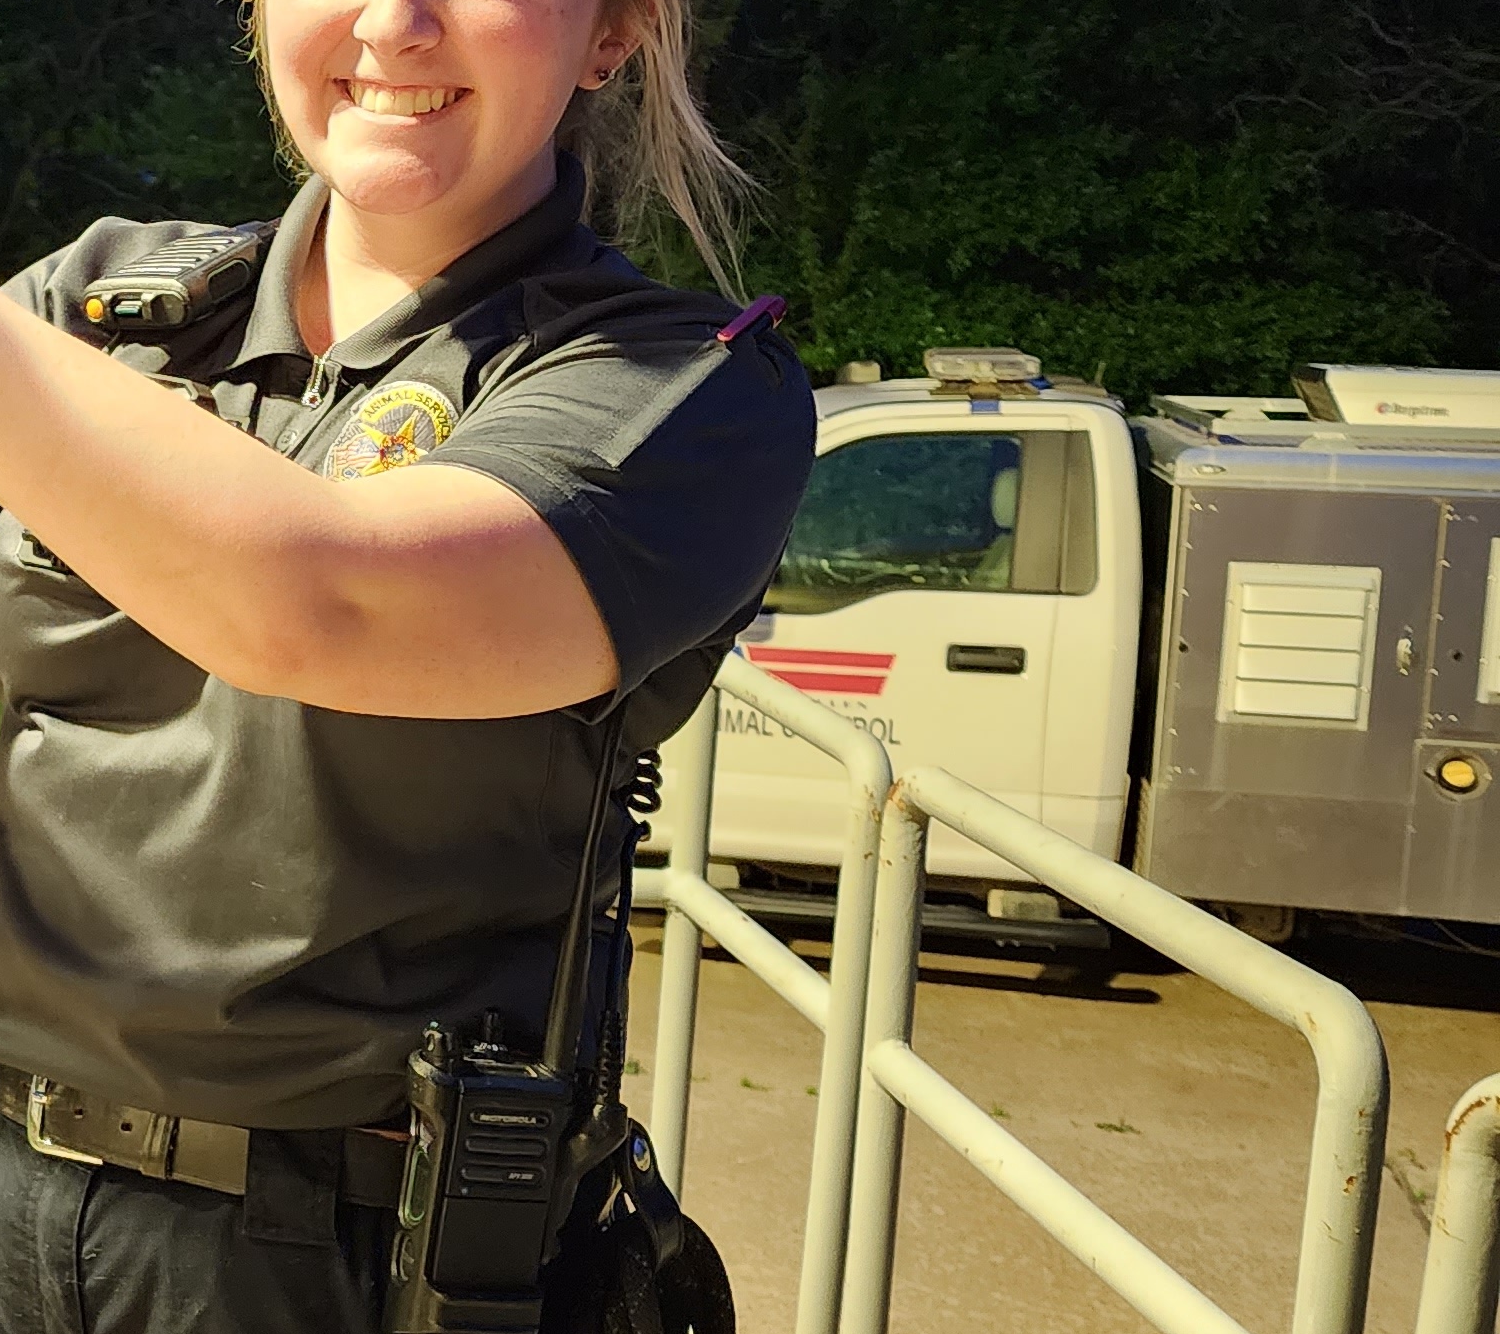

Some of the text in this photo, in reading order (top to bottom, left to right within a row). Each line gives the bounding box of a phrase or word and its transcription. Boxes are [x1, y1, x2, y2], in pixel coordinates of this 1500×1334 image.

[363, 390, 451, 441] ANIMAL SERVIC
[479, 1114, 537, 1124] MOTOROLA
